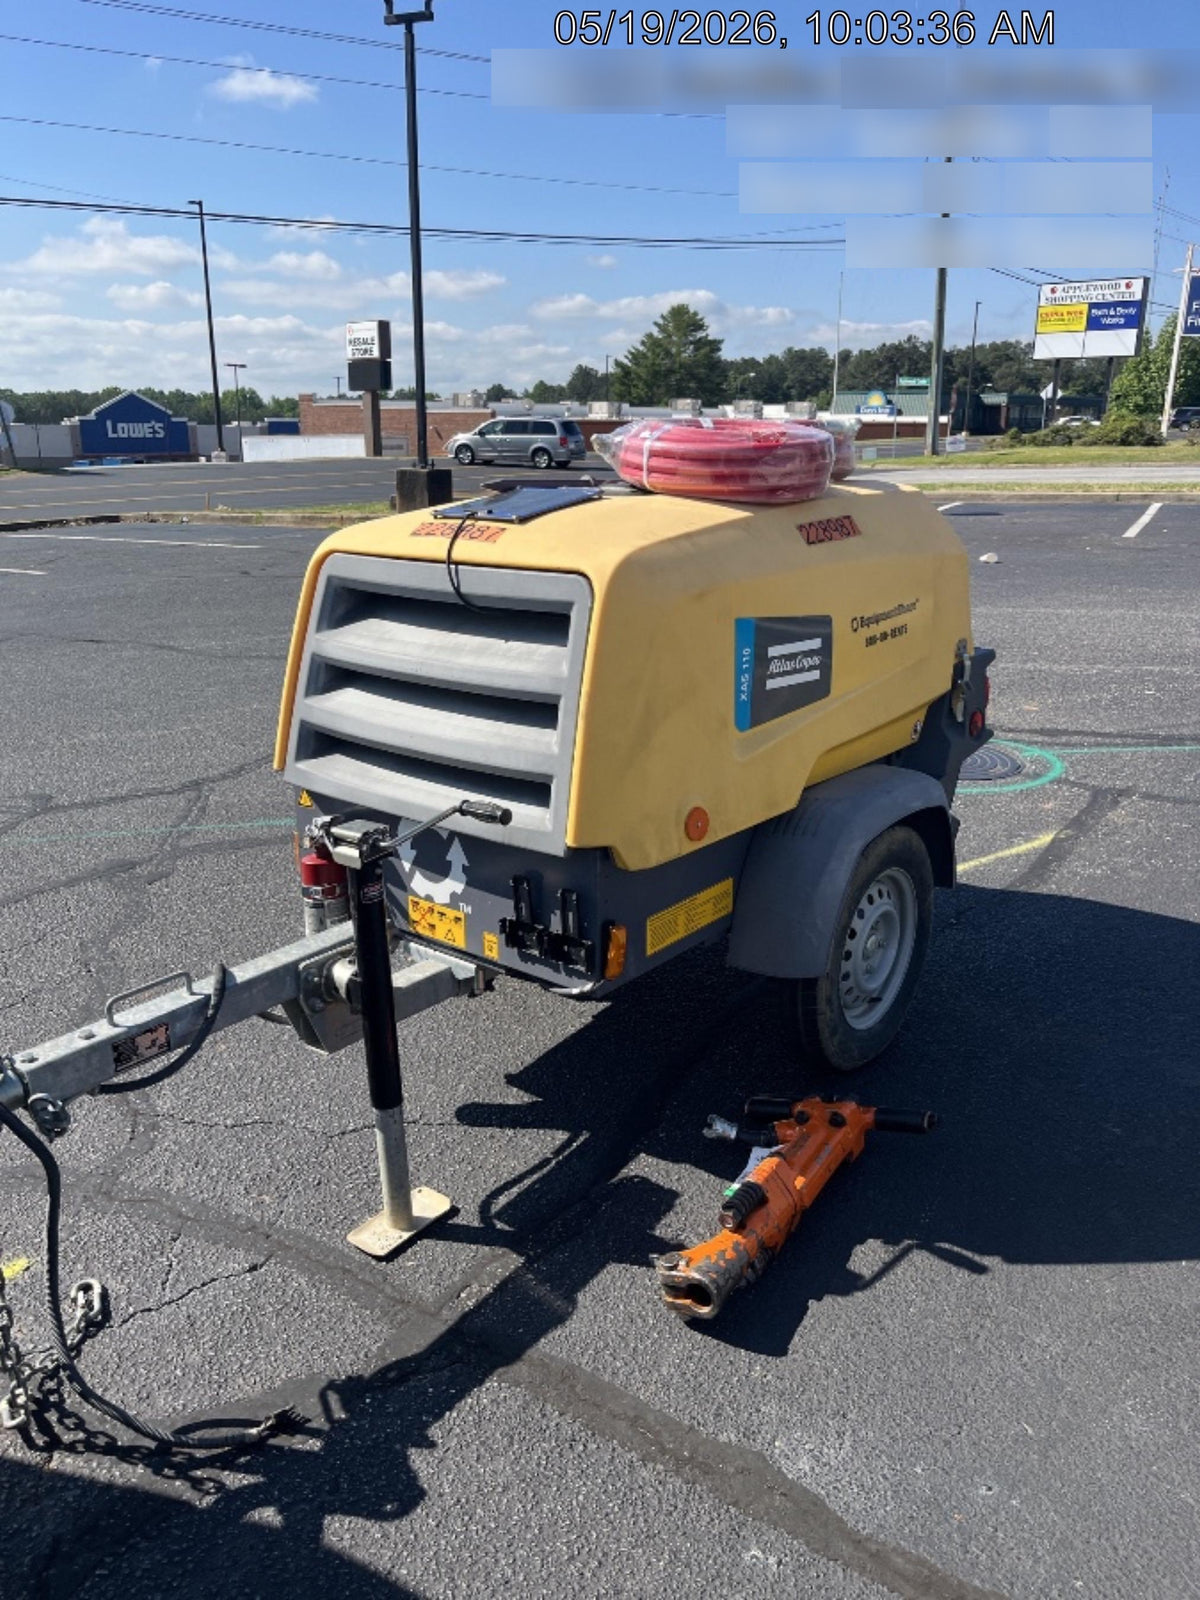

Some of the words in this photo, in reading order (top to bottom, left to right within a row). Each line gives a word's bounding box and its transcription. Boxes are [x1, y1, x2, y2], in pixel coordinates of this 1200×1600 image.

[1061, 282, 1121, 293] APPLEWOOD
[1045, 294, 1094, 304] SHOPPING
[1095, 291, 1136, 302] CENTER
[348, 336, 376, 348] RESALE
[106, 420, 165, 438] LOWE'S
[742, 648, 752, 669] 110
[740, 674, 750, 702] XAS
